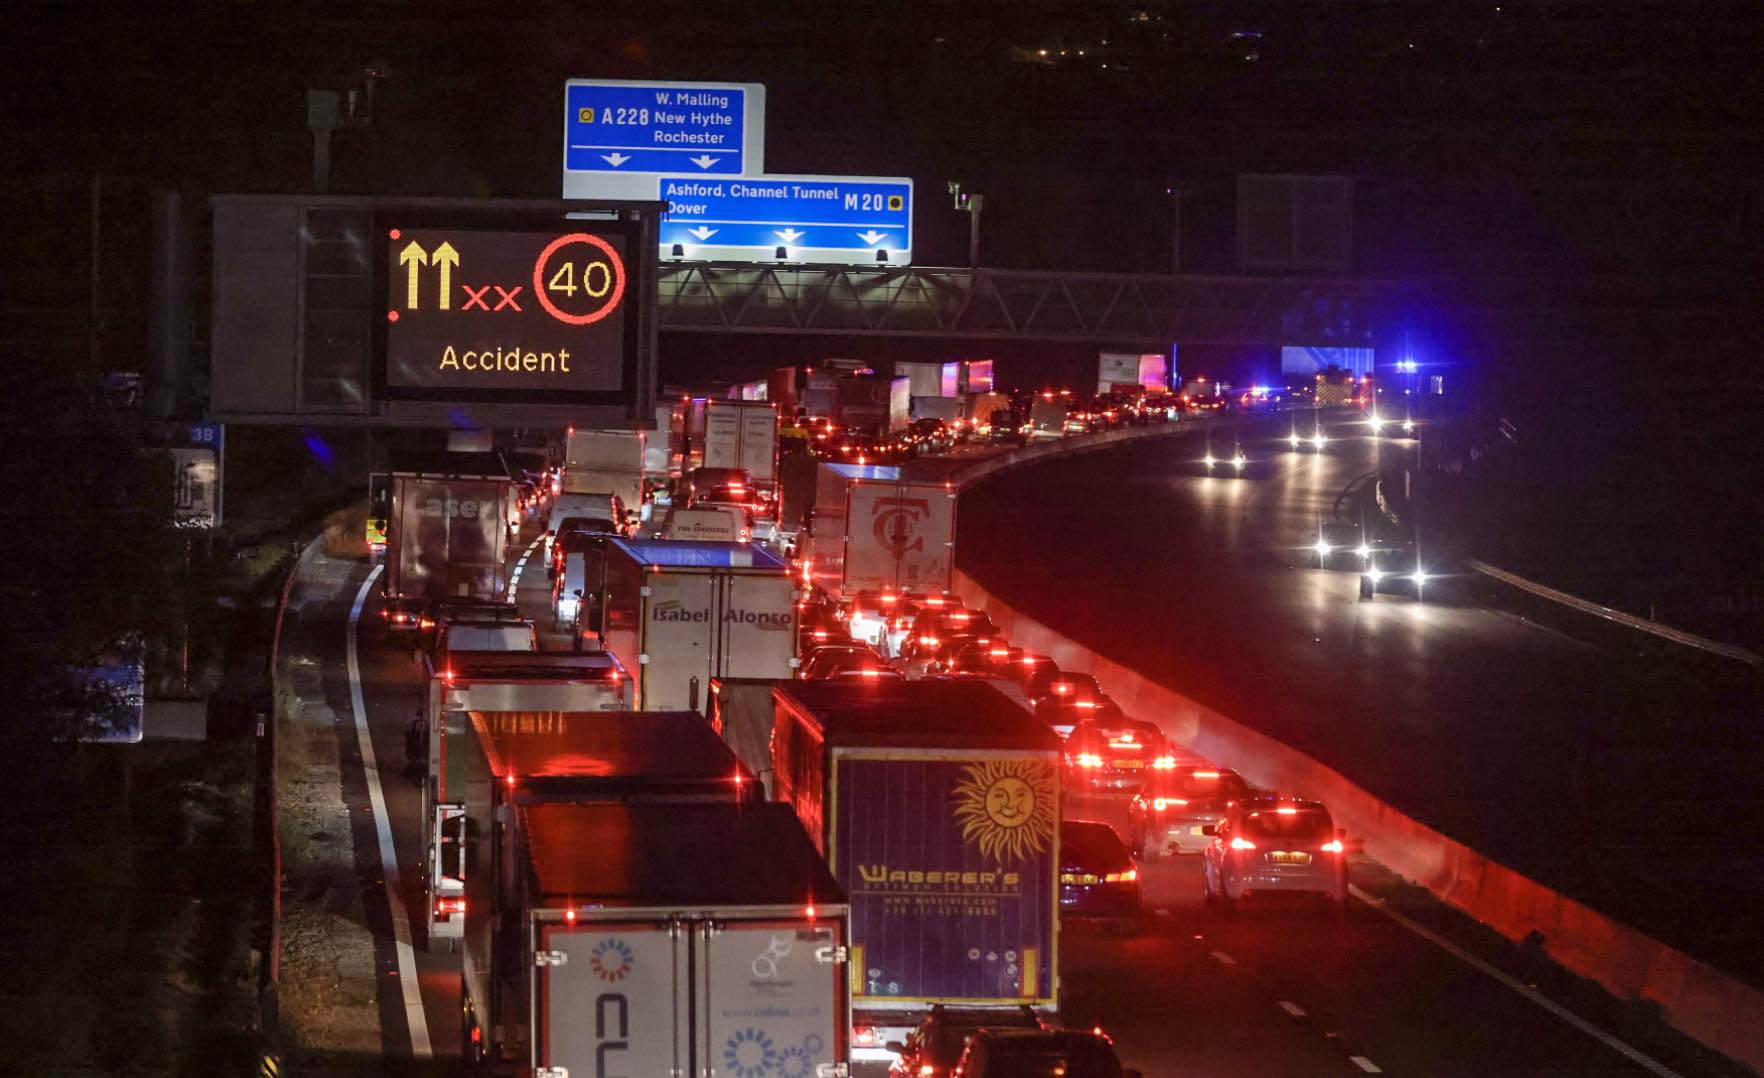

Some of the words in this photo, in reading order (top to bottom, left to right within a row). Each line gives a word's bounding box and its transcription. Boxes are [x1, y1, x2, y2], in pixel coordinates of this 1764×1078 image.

[656, 93, 673, 106] W.
[677, 93, 728, 109] Malling
[655, 111, 686, 125] New
[691, 112, 732, 127] Hythe
[654, 131, 724, 145] Rochester
[667, 183, 726, 198] Ashford,
[730, 184, 788, 199] Channel
[792, 186, 839, 200] Tunnel
[668, 201, 707, 215] Dover
[549, 261, 611, 297] 40
[439, 346, 570, 372] Accident
[653, 607, 709, 624] Isabel
[723, 608, 792, 625] Alonso
